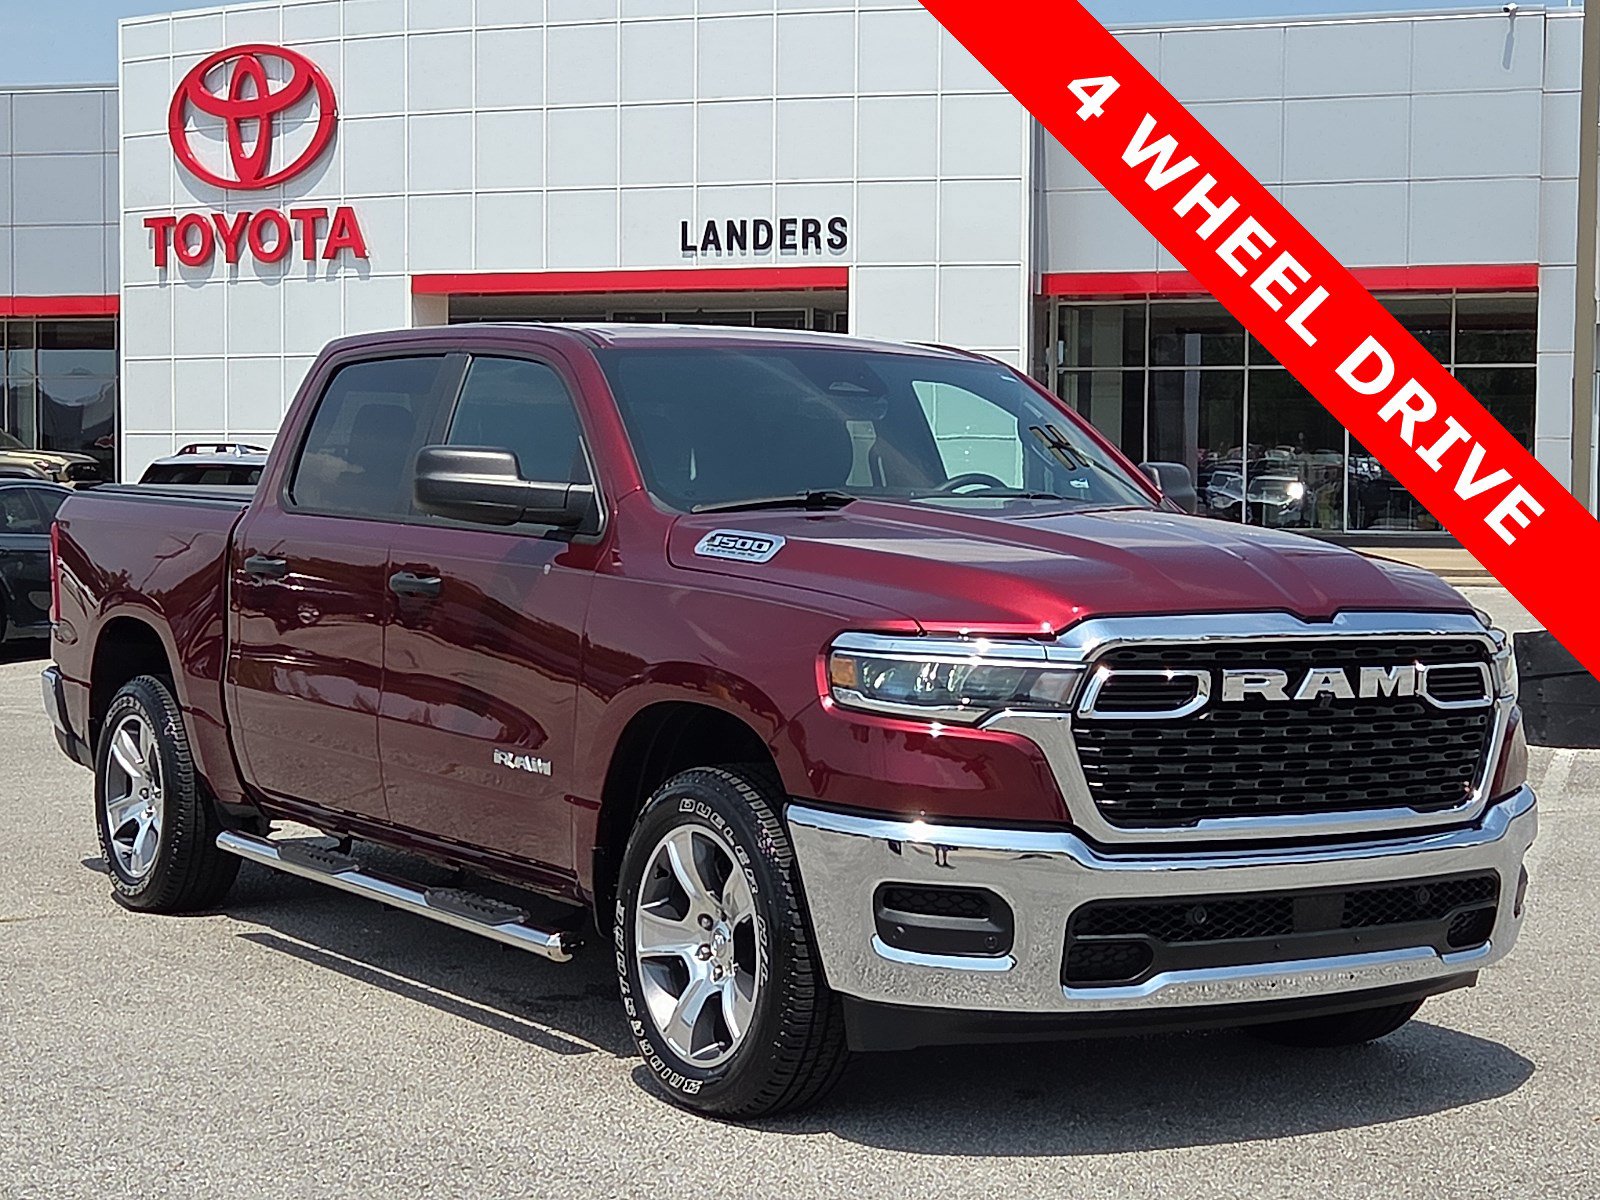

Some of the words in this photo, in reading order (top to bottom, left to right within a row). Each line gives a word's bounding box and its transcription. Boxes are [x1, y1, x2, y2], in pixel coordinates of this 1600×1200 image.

[144, 207, 368, 267] TOYOTA
[681, 216, 848, 253] LANDERS
[704, 533, 772, 553] 1500
[1222, 665, 1416, 701] RAM
[493, 748, 552, 777] RAM
[678, 798, 760, 895] DUELER
[613, 899, 703, 1095] BRIDGESTONE
